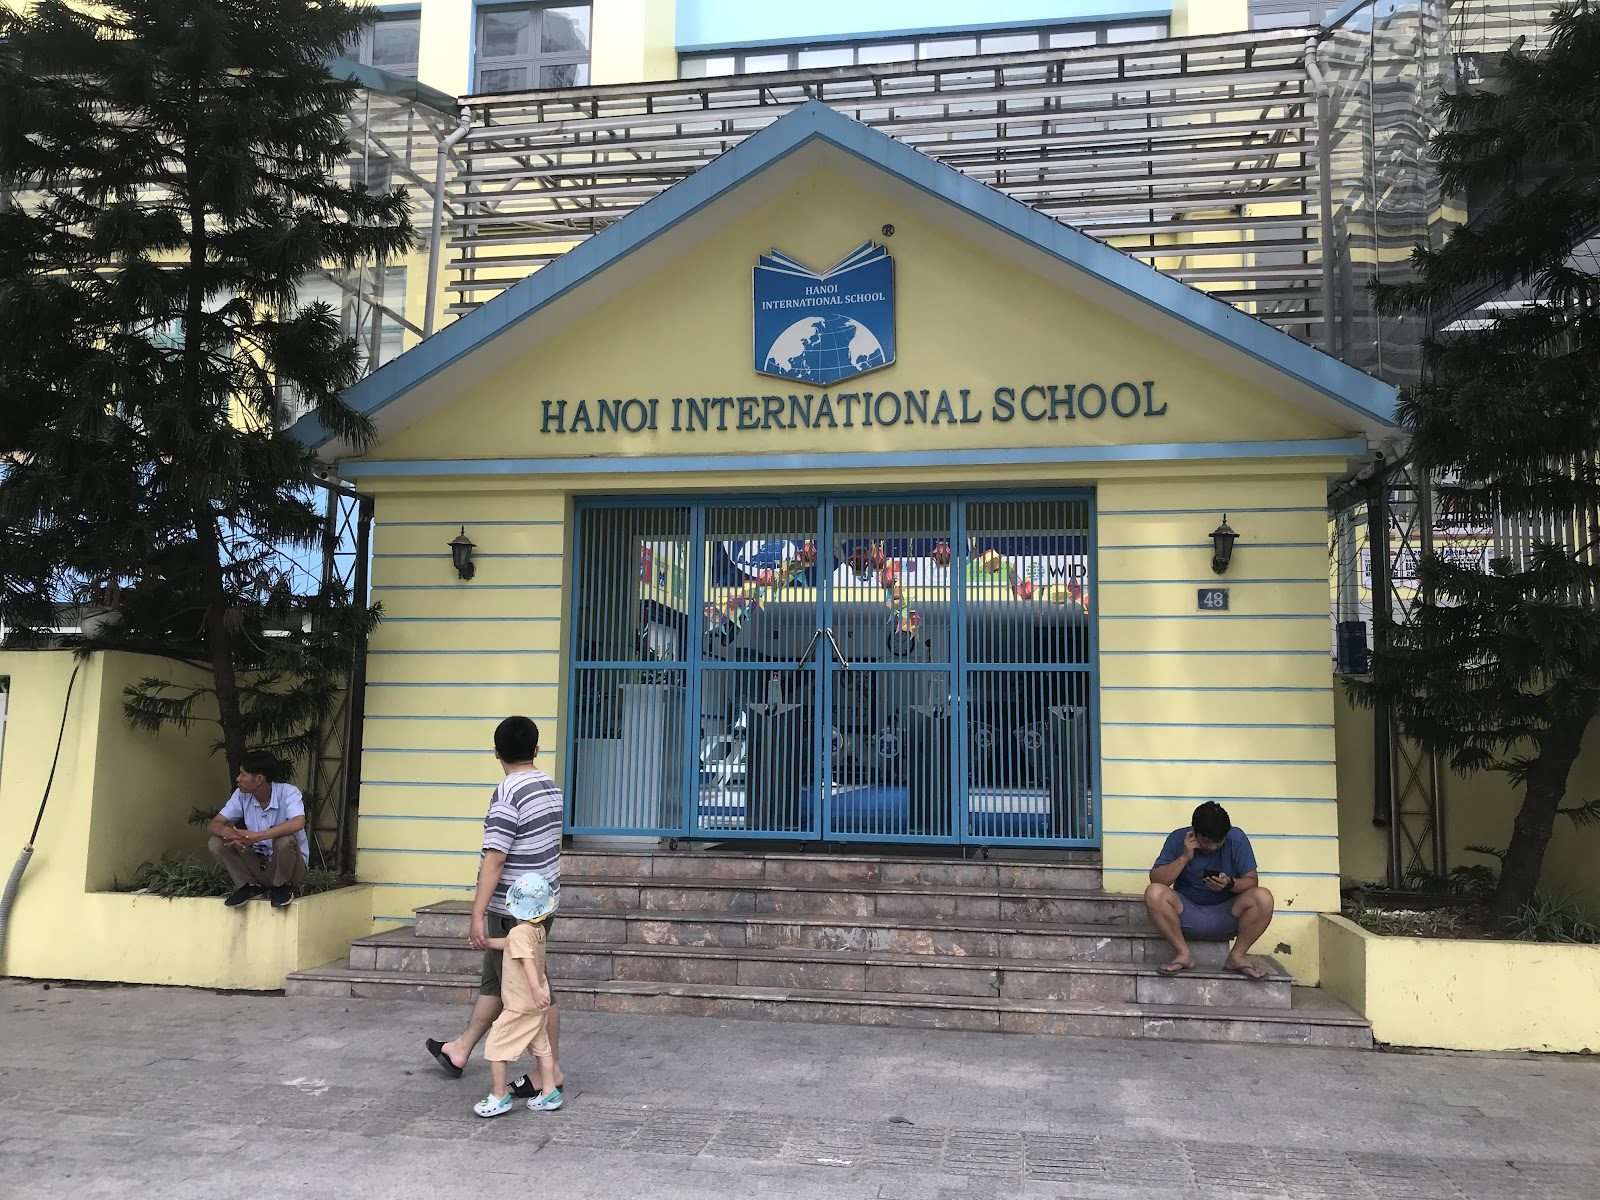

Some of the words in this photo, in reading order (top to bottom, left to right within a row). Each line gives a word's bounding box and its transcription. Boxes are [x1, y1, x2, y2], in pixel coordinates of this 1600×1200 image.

[805, 284, 838, 296] HANOI
[762, 296, 843, 310] INTERNATIONAL
[844, 292, 886, 304] SCHOOL
[540, 398, 658, 433] HANOI
[671, 389, 982, 431] INTERNATIONAL
[992, 380, 1168, 422] SCHOOL
[1049, 564, 1088, 578] WID
[1203, 592, 1224, 608] 48
